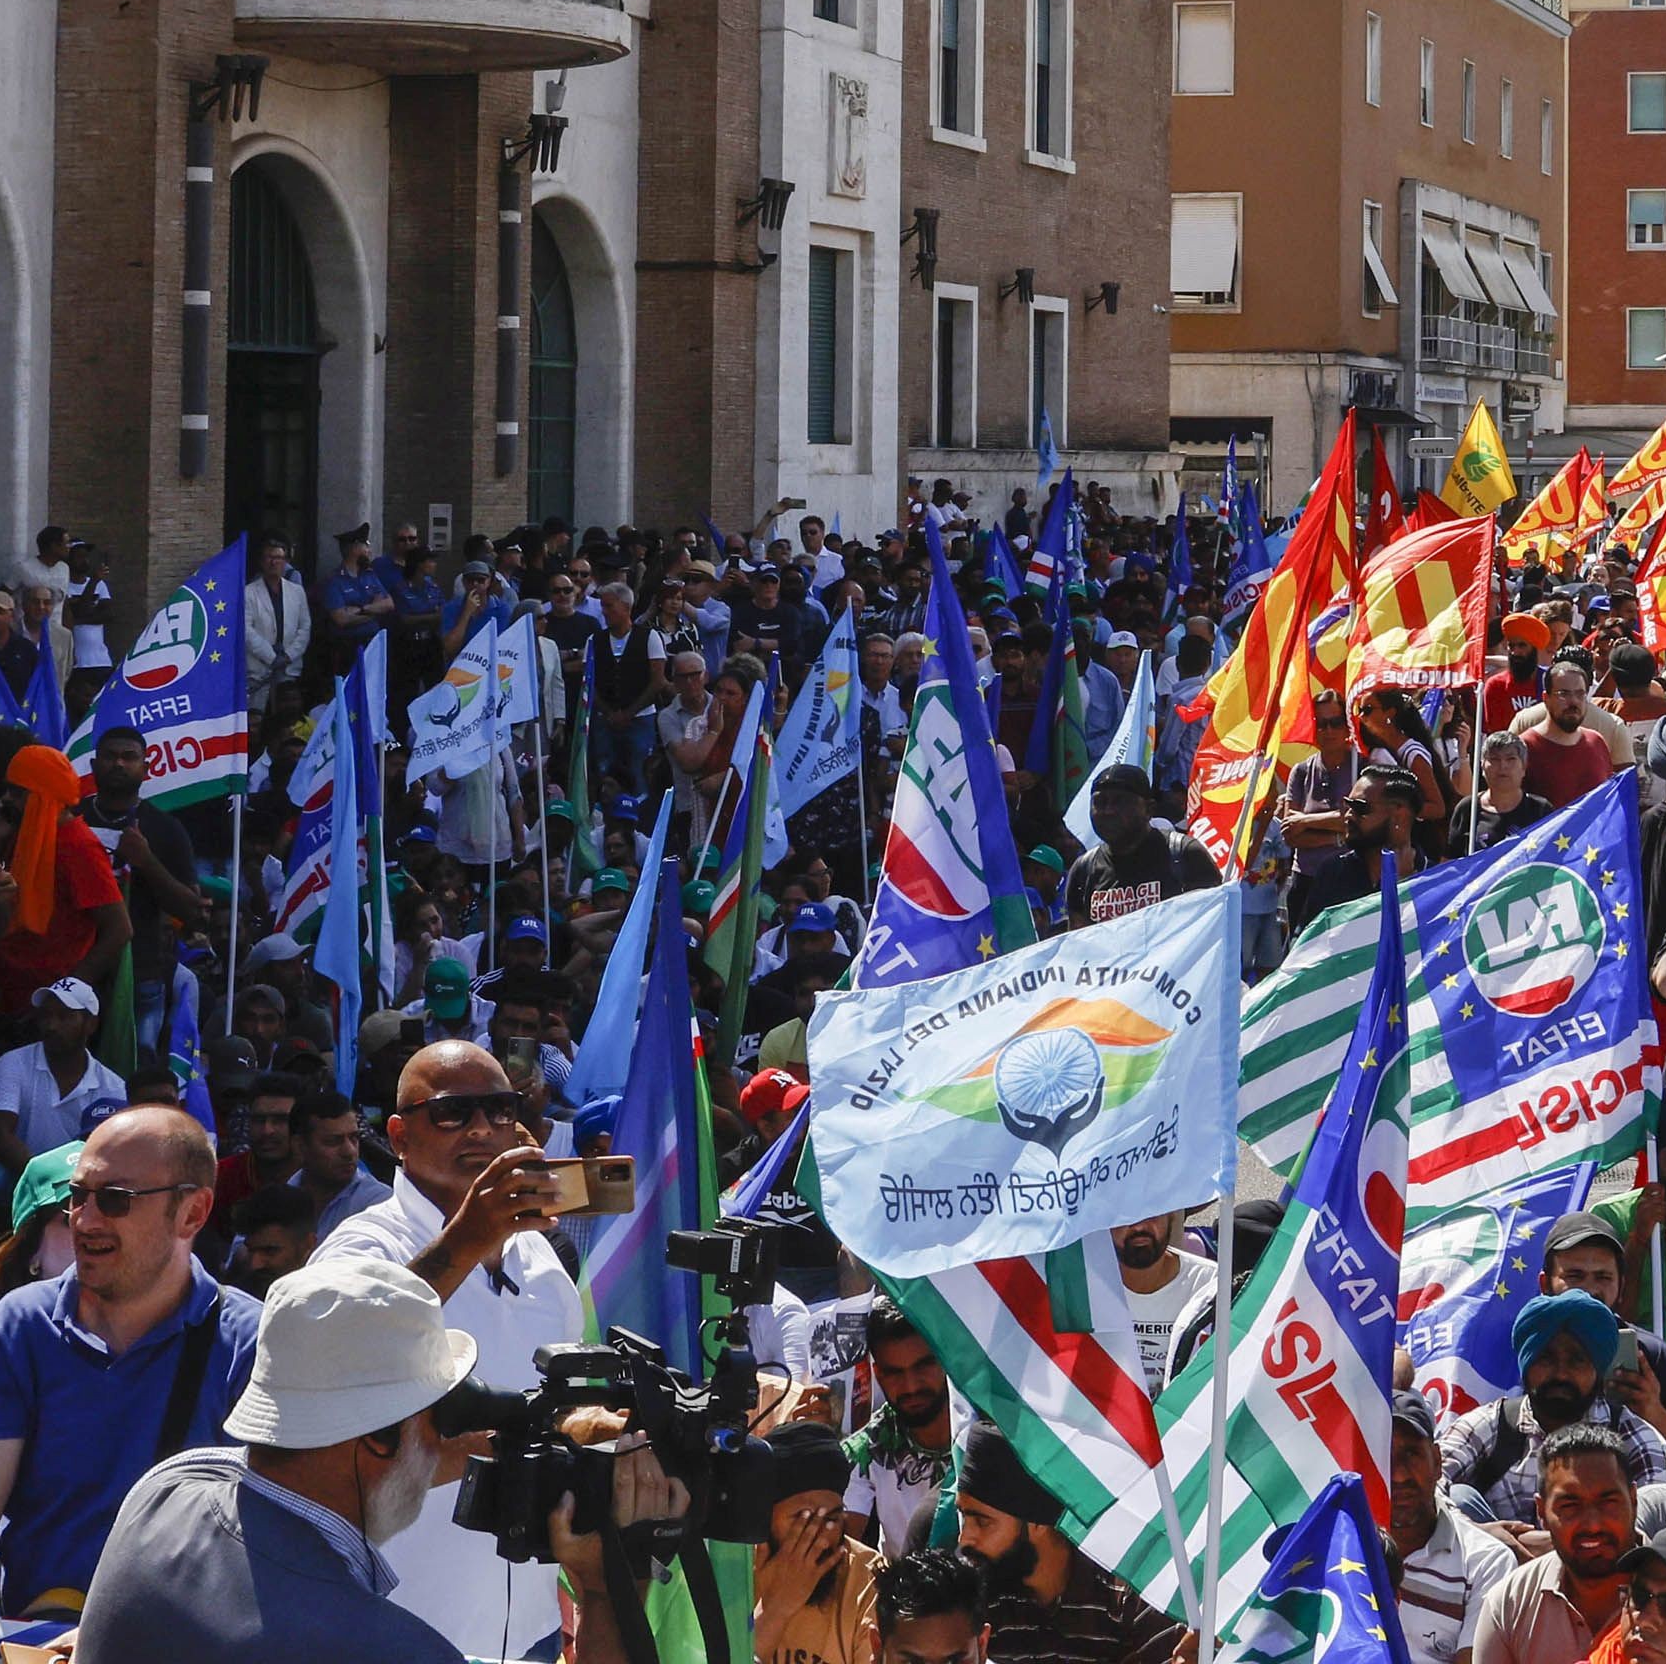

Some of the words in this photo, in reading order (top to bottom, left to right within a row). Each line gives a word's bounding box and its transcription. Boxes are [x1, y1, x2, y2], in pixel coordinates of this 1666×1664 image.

[1090, 887, 1134, 909] PRIMA
[1136, 881, 1162, 900] GLI
[800, 907, 818, 916] UIL
[521, 918, 539, 929] UIL
[1310, 1201, 1395, 1328] EFFAT
